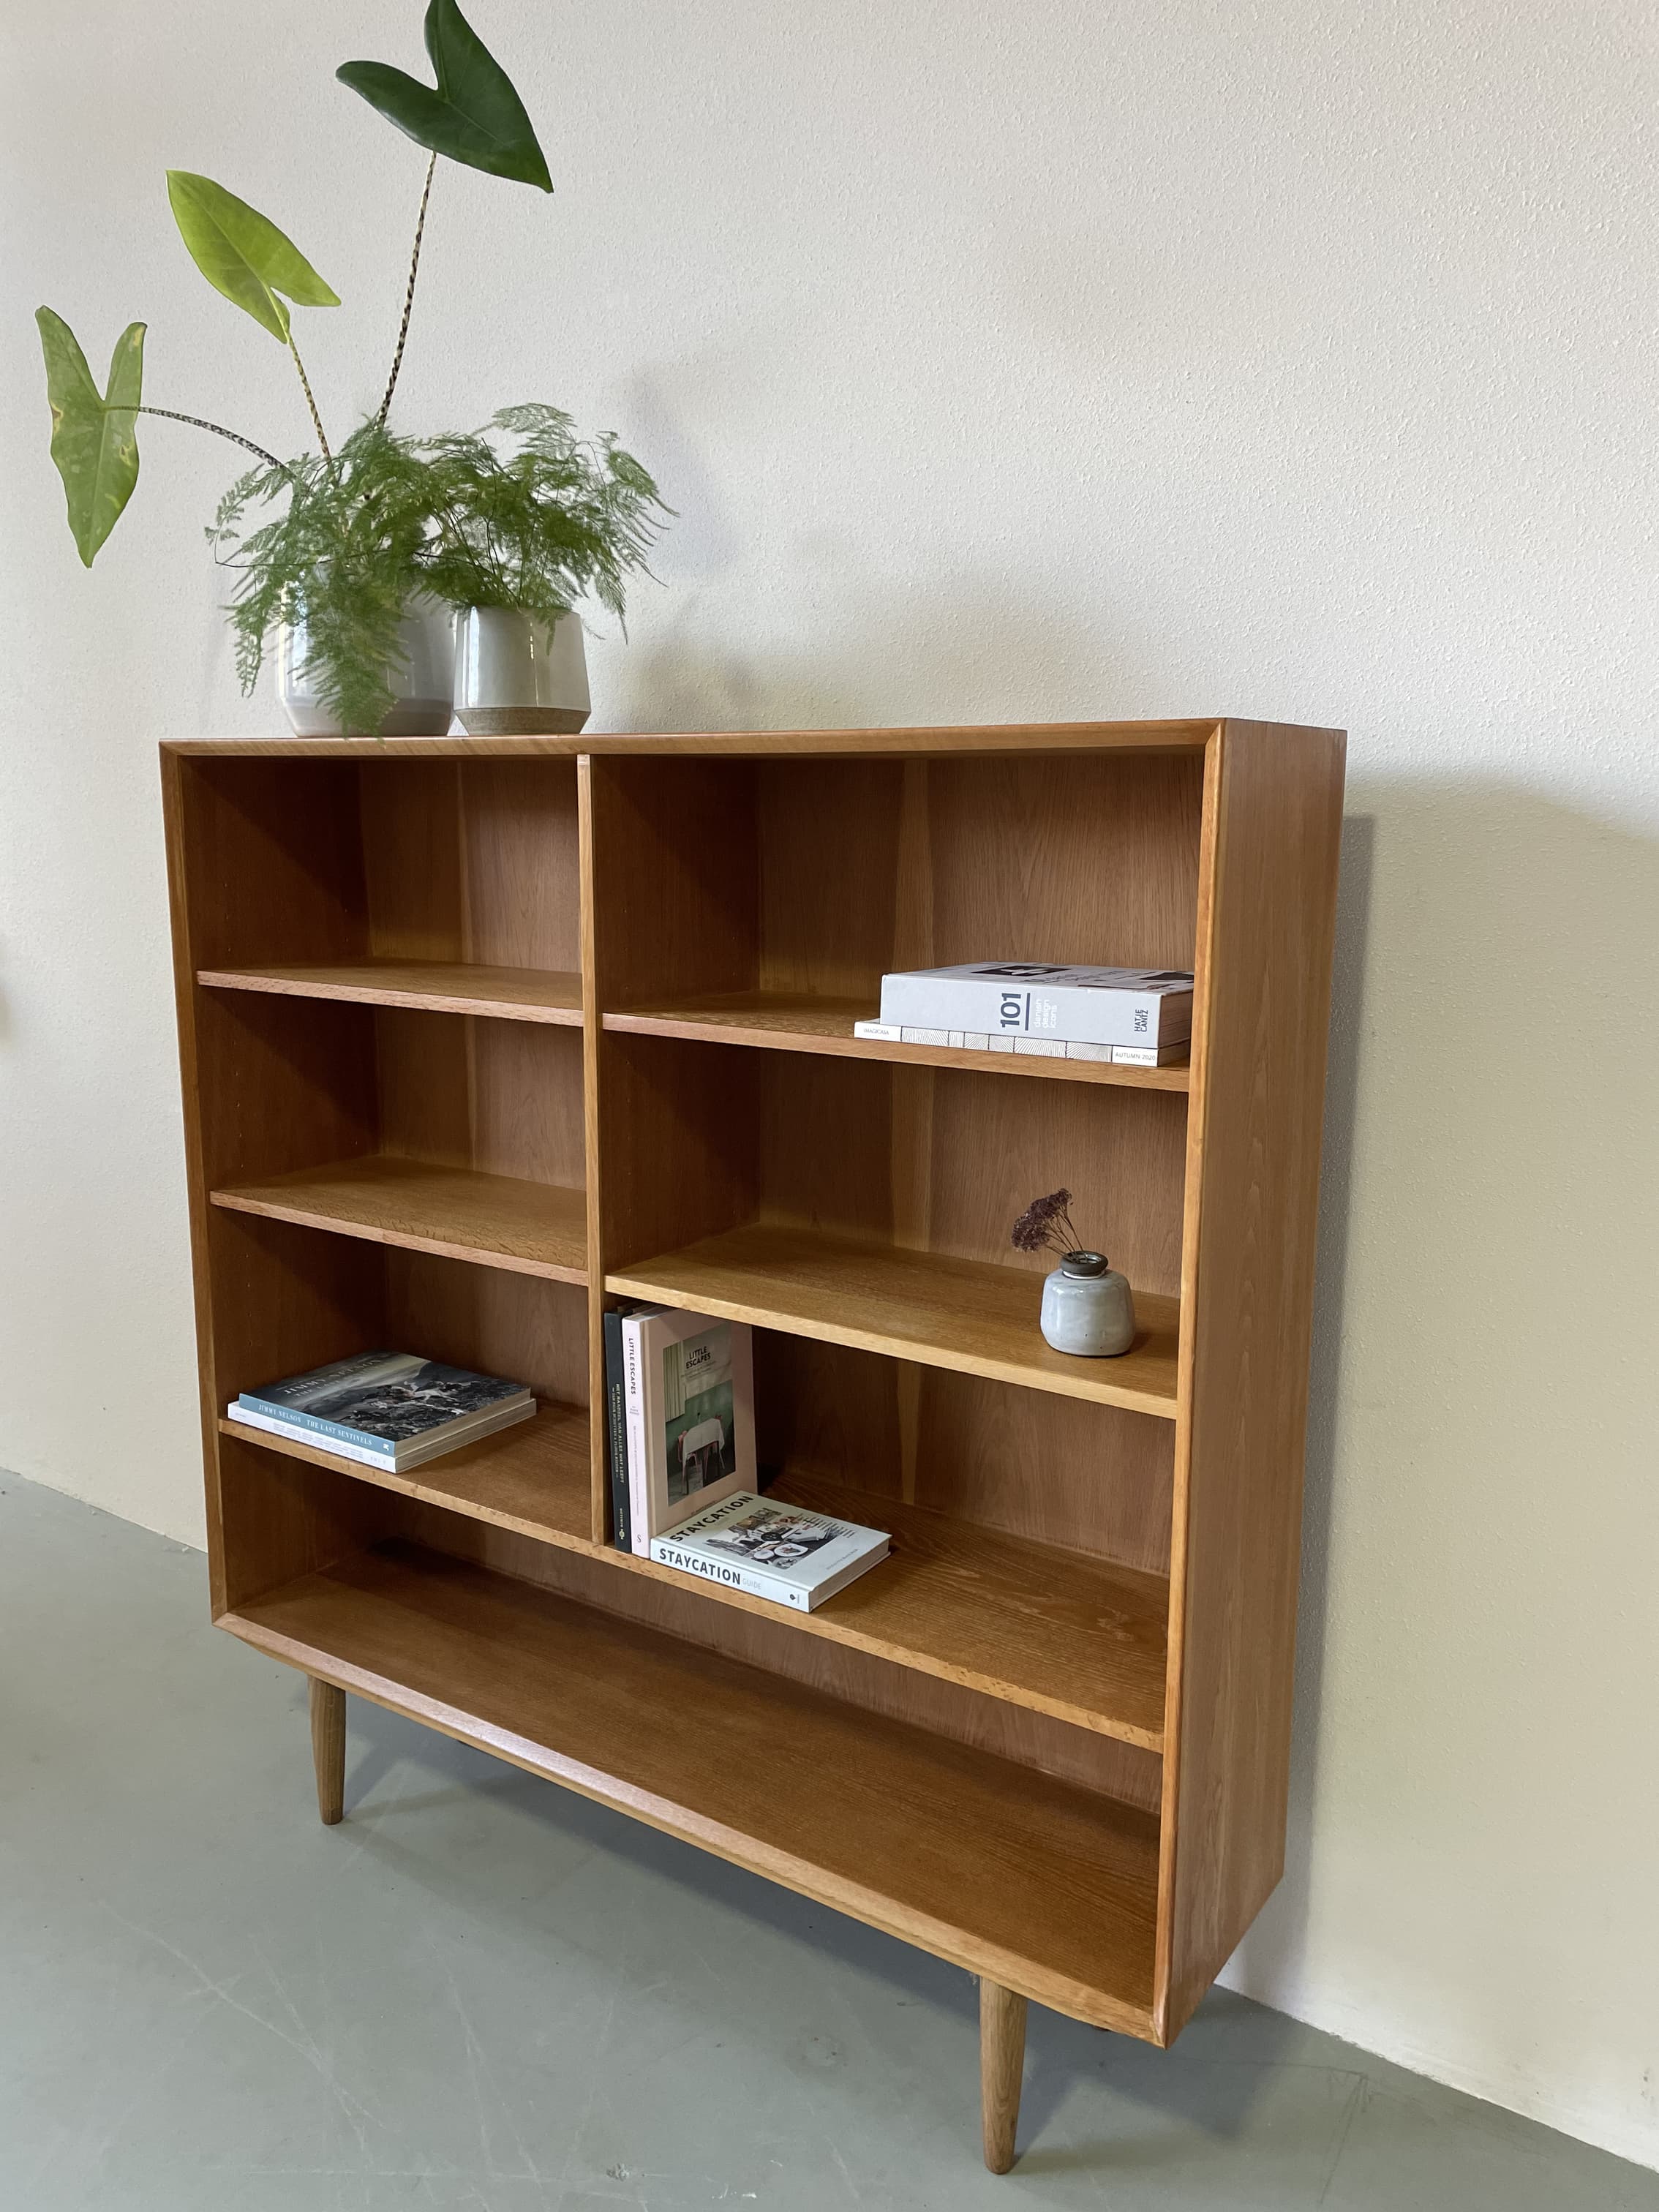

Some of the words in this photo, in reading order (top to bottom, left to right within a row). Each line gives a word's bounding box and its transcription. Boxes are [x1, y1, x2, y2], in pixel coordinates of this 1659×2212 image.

[1000, 993, 1021, 1028] 101
[1034, 999, 1042, 1028] danish
[1042, 999, 1051, 1028] design
[1048, 1005, 1058, 1028] icons
[1134, 1009, 1142, 1031] HATJE
[685, 1353, 711, 1369] ESCAPES
[689, 1346, 707, 1360] LITTLE
[258, 1404, 276, 1416] JIMMY
[278, 1410, 301, 1423] NELSON
[306, 1419, 318, 1428] THE
[320, 1423, 336, 1434] LAST
[337, 1428, 372, 1446] SENTINELS
[669, 1495, 754, 1542] STAYCATION
[659, 1548, 741, 1585] STAYCATION
[742, 1578, 761, 1590] GUIDE
